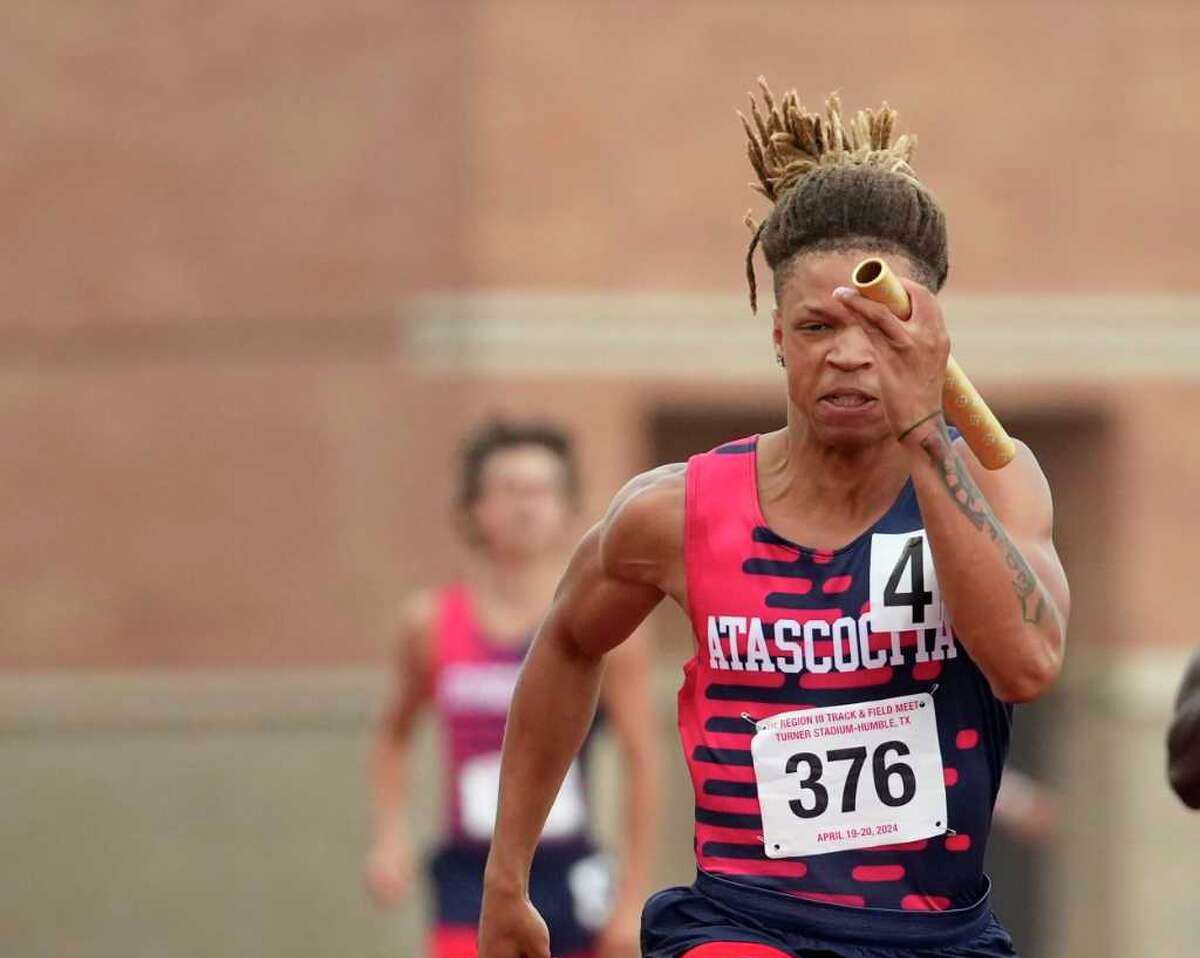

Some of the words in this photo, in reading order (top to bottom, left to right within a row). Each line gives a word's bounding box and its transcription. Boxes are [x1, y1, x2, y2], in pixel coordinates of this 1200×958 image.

[883, 535, 933, 625] 4
[775, 729, 812, 742] TURNER
[899, 715, 912, 726] TX
[780, 715, 813, 729] REGION
[815, 713, 825, 725] III
[826, 710, 857, 723] TRACK
[858, 710, 866, 719] &
[868, 705, 893, 717] FIELD
[895, 700, 919, 713] MEET
[785, 740, 918, 820] 376
[816, 830, 845, 843] APRIL
[876, 823, 899, 836] 2024
